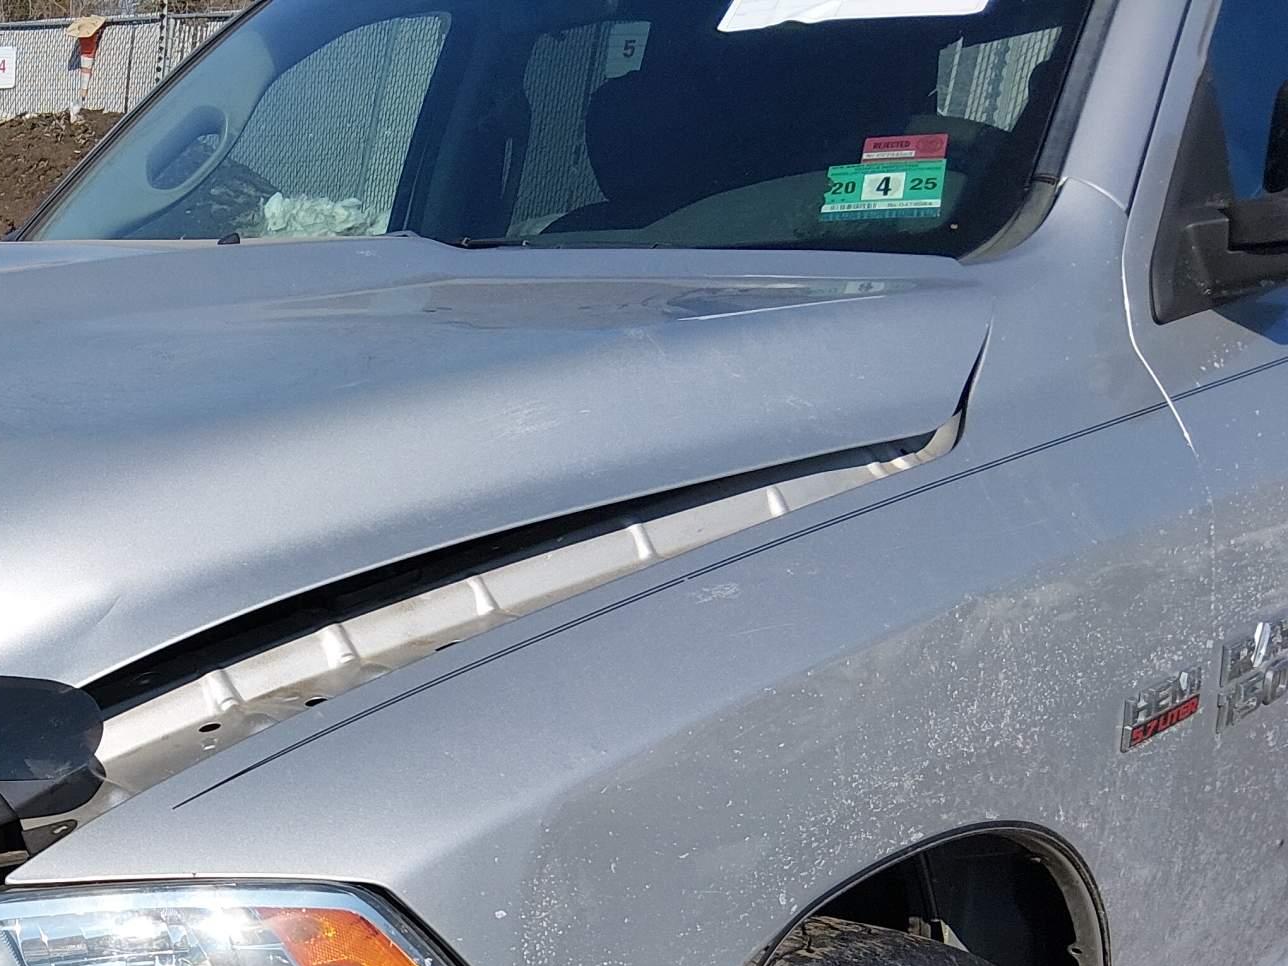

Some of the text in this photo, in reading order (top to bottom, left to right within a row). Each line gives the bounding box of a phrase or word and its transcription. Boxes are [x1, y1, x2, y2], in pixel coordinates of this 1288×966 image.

[623, 39, 636, 58] 5
[872, 140, 911, 150] REJECTED
[831, 176, 938, 196] 20 4 25
